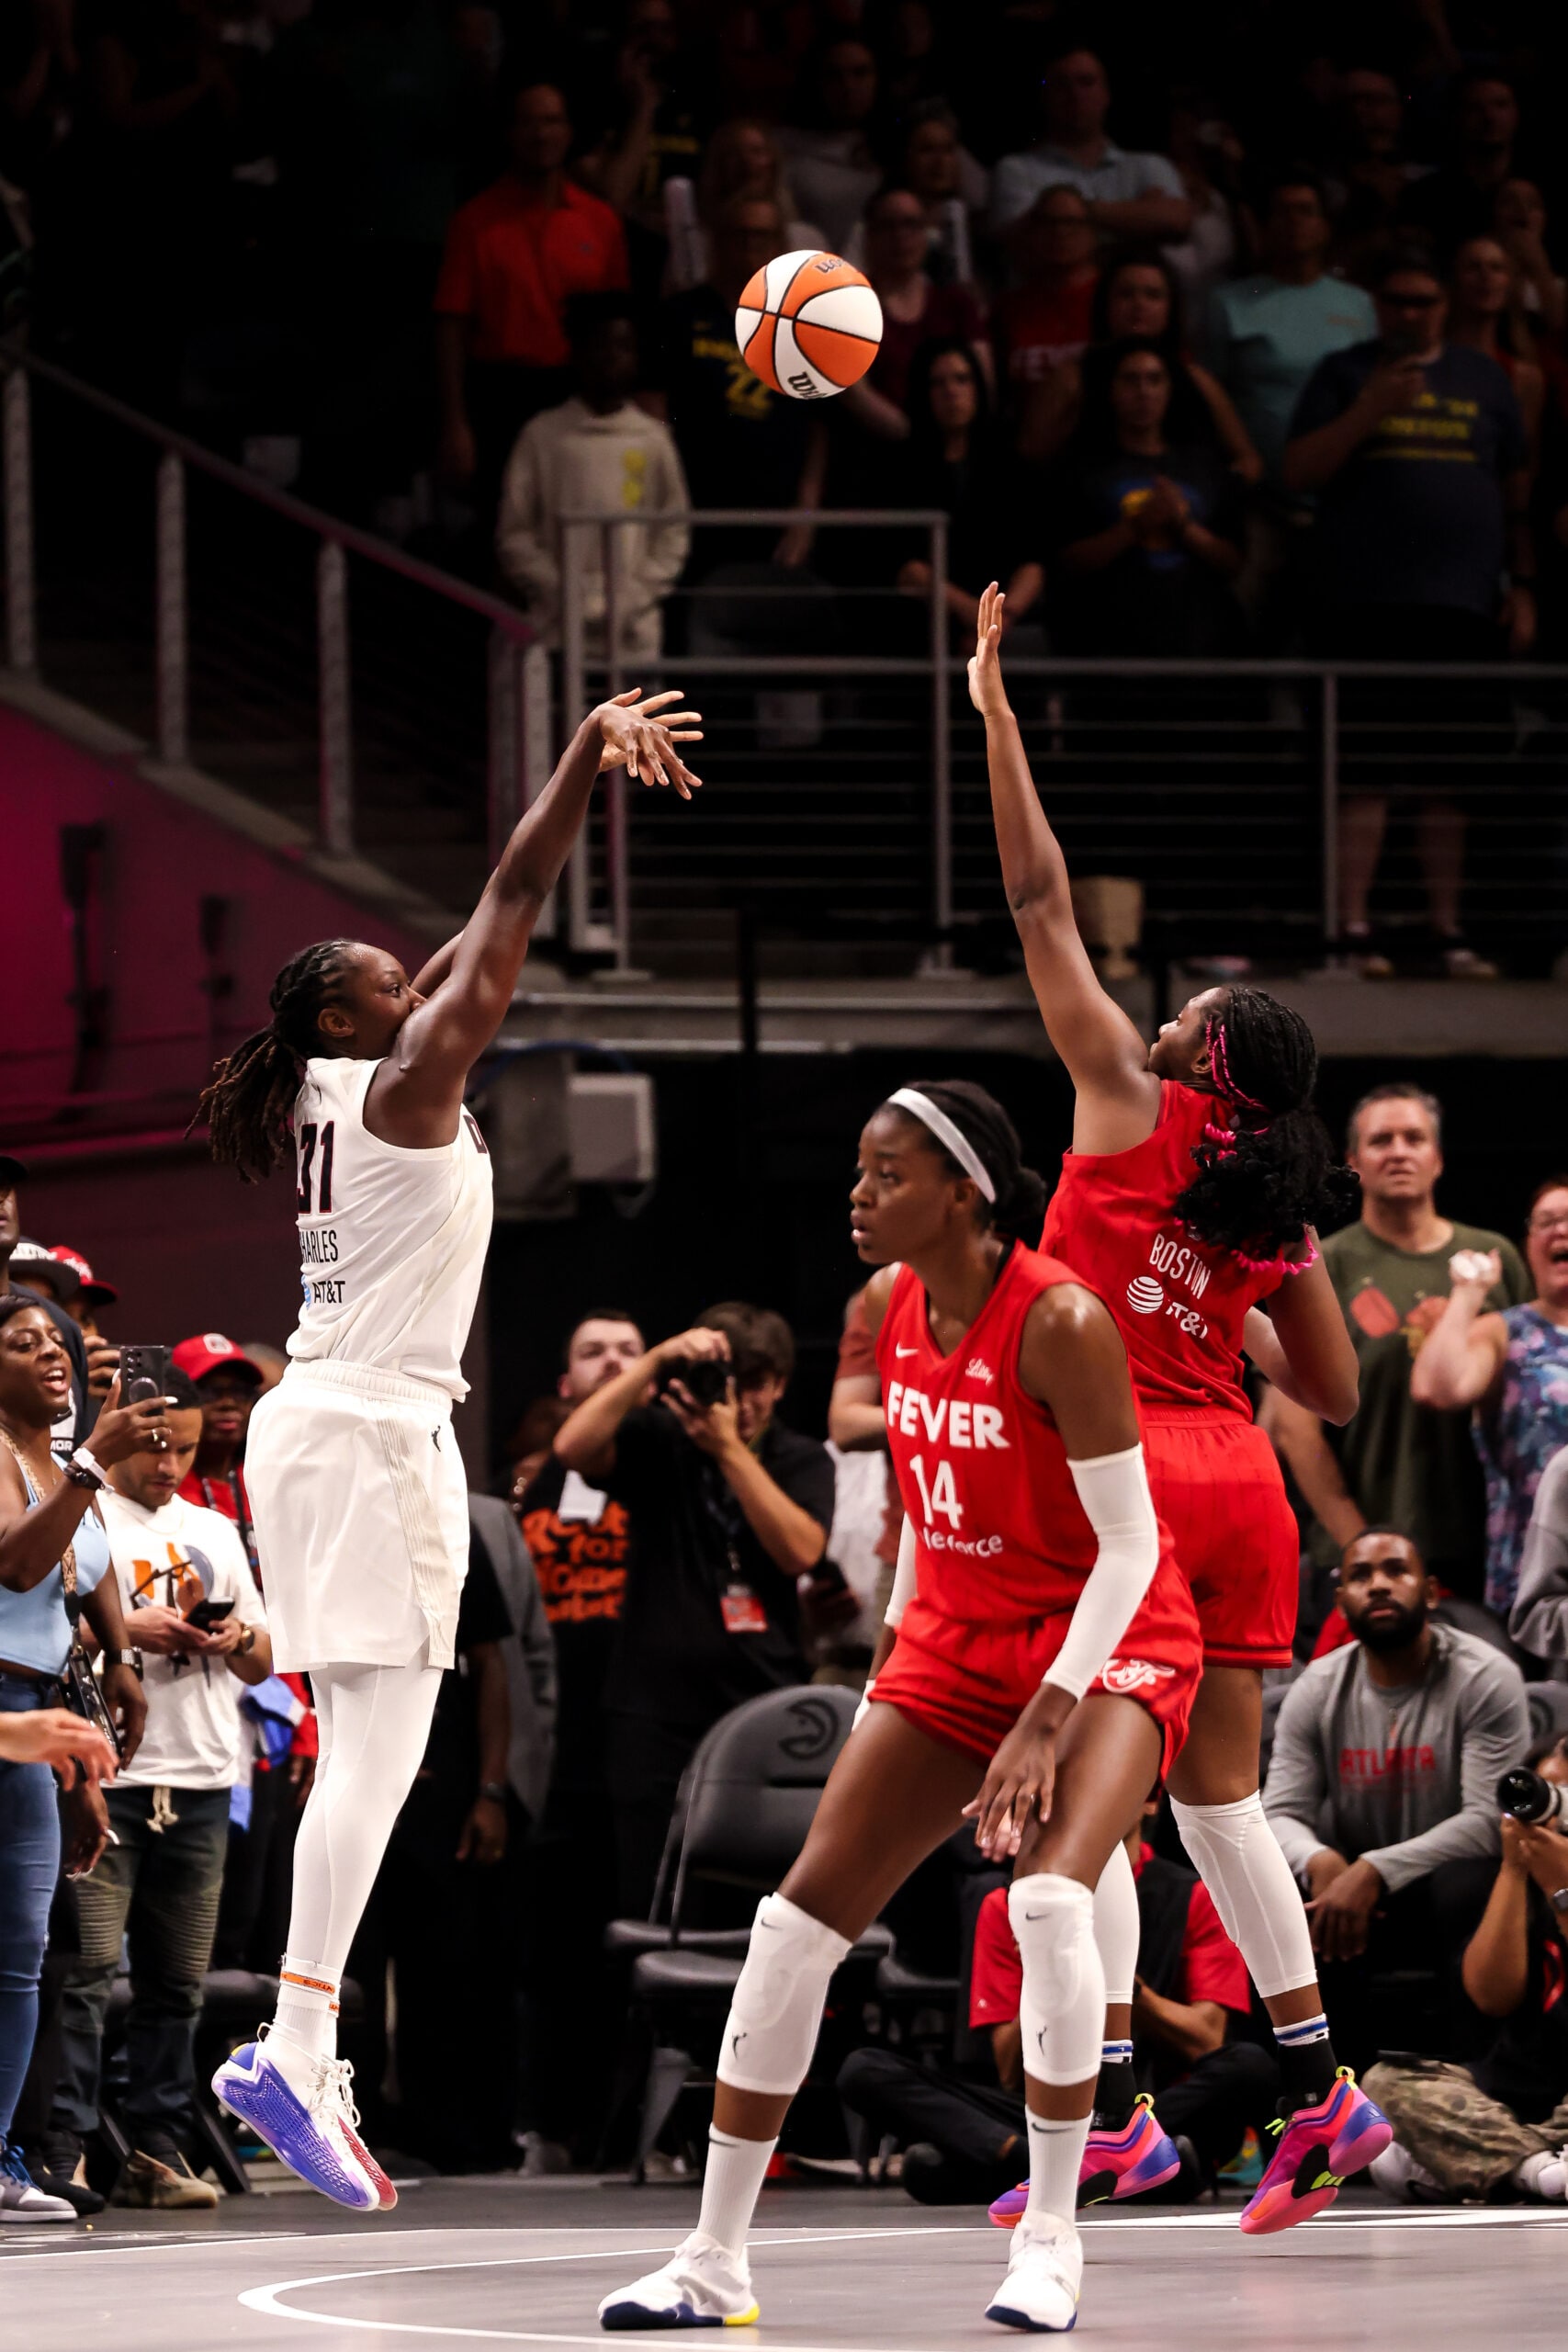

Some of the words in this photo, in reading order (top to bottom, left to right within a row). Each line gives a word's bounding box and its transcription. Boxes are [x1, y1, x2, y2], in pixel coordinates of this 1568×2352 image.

[299, 1230, 338, 1263] HARLES
[1149, 1233, 1211, 1299] BOSTON
[312, 1281, 345, 1303] AT&T
[887, 1381, 1011, 1449] FEVER
[909, 1453, 964, 1531] 14
